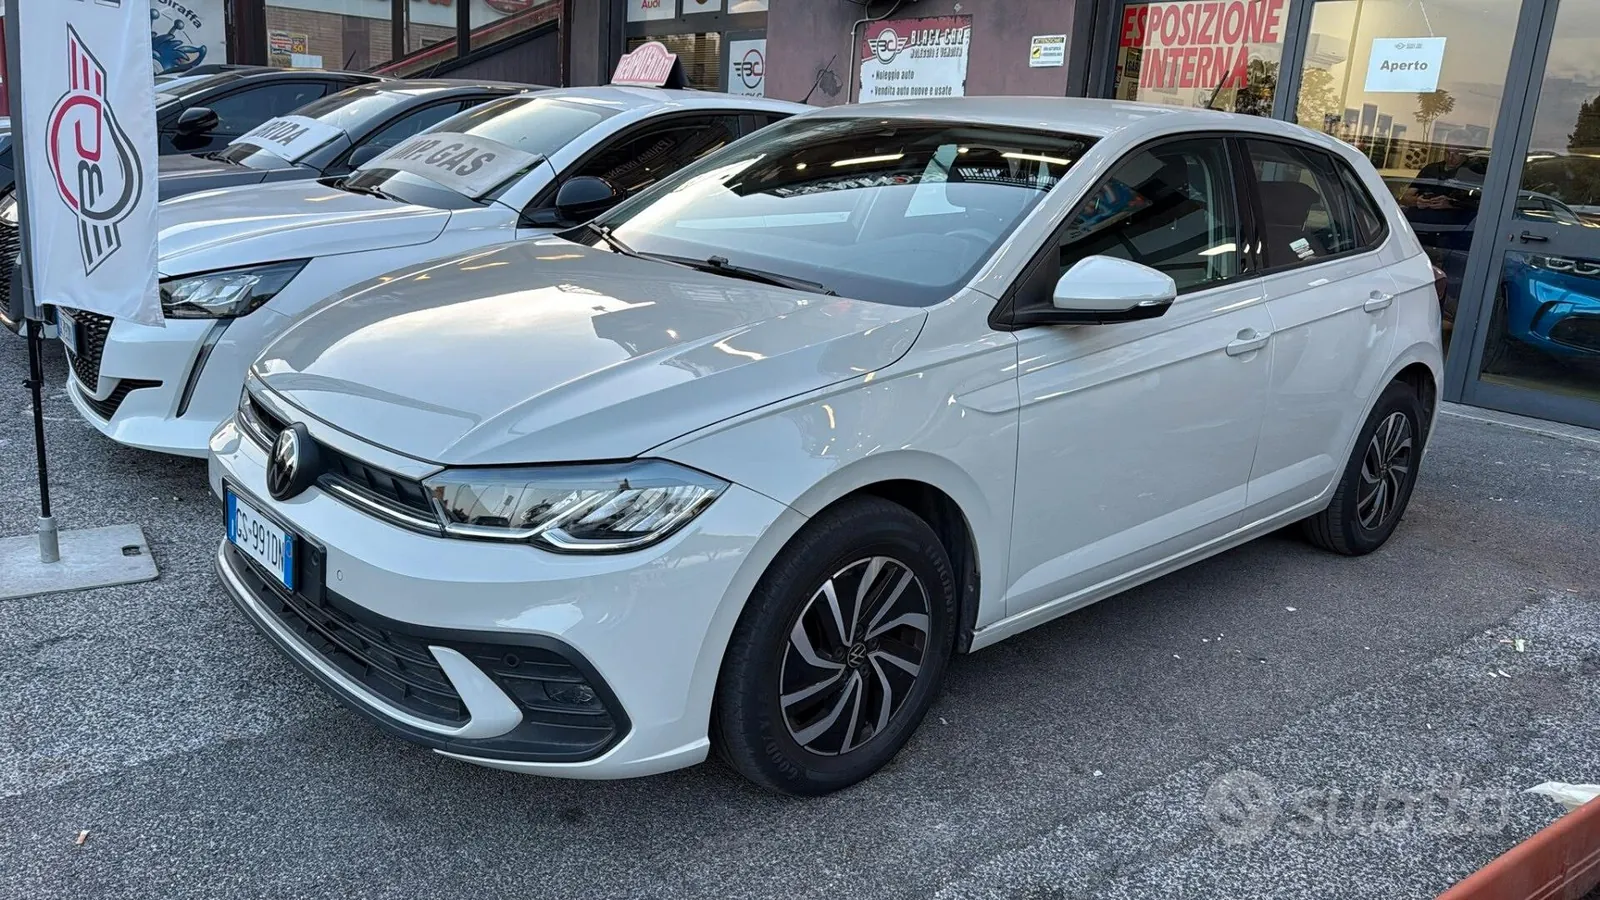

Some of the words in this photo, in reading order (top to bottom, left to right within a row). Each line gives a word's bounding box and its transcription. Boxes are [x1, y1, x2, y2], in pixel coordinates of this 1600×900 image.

[1120, 0, 1283, 47] ESPOSIZIONE
[911, 29, 941, 46] BLACK
[944, 28, 963, 45] CAR
[901, 70, 914, 80] auto
[1140, 45, 1248, 88] INTERNA
[1380, 60, 1428, 73] Aperto
[425, 143, 496, 176] GAS
